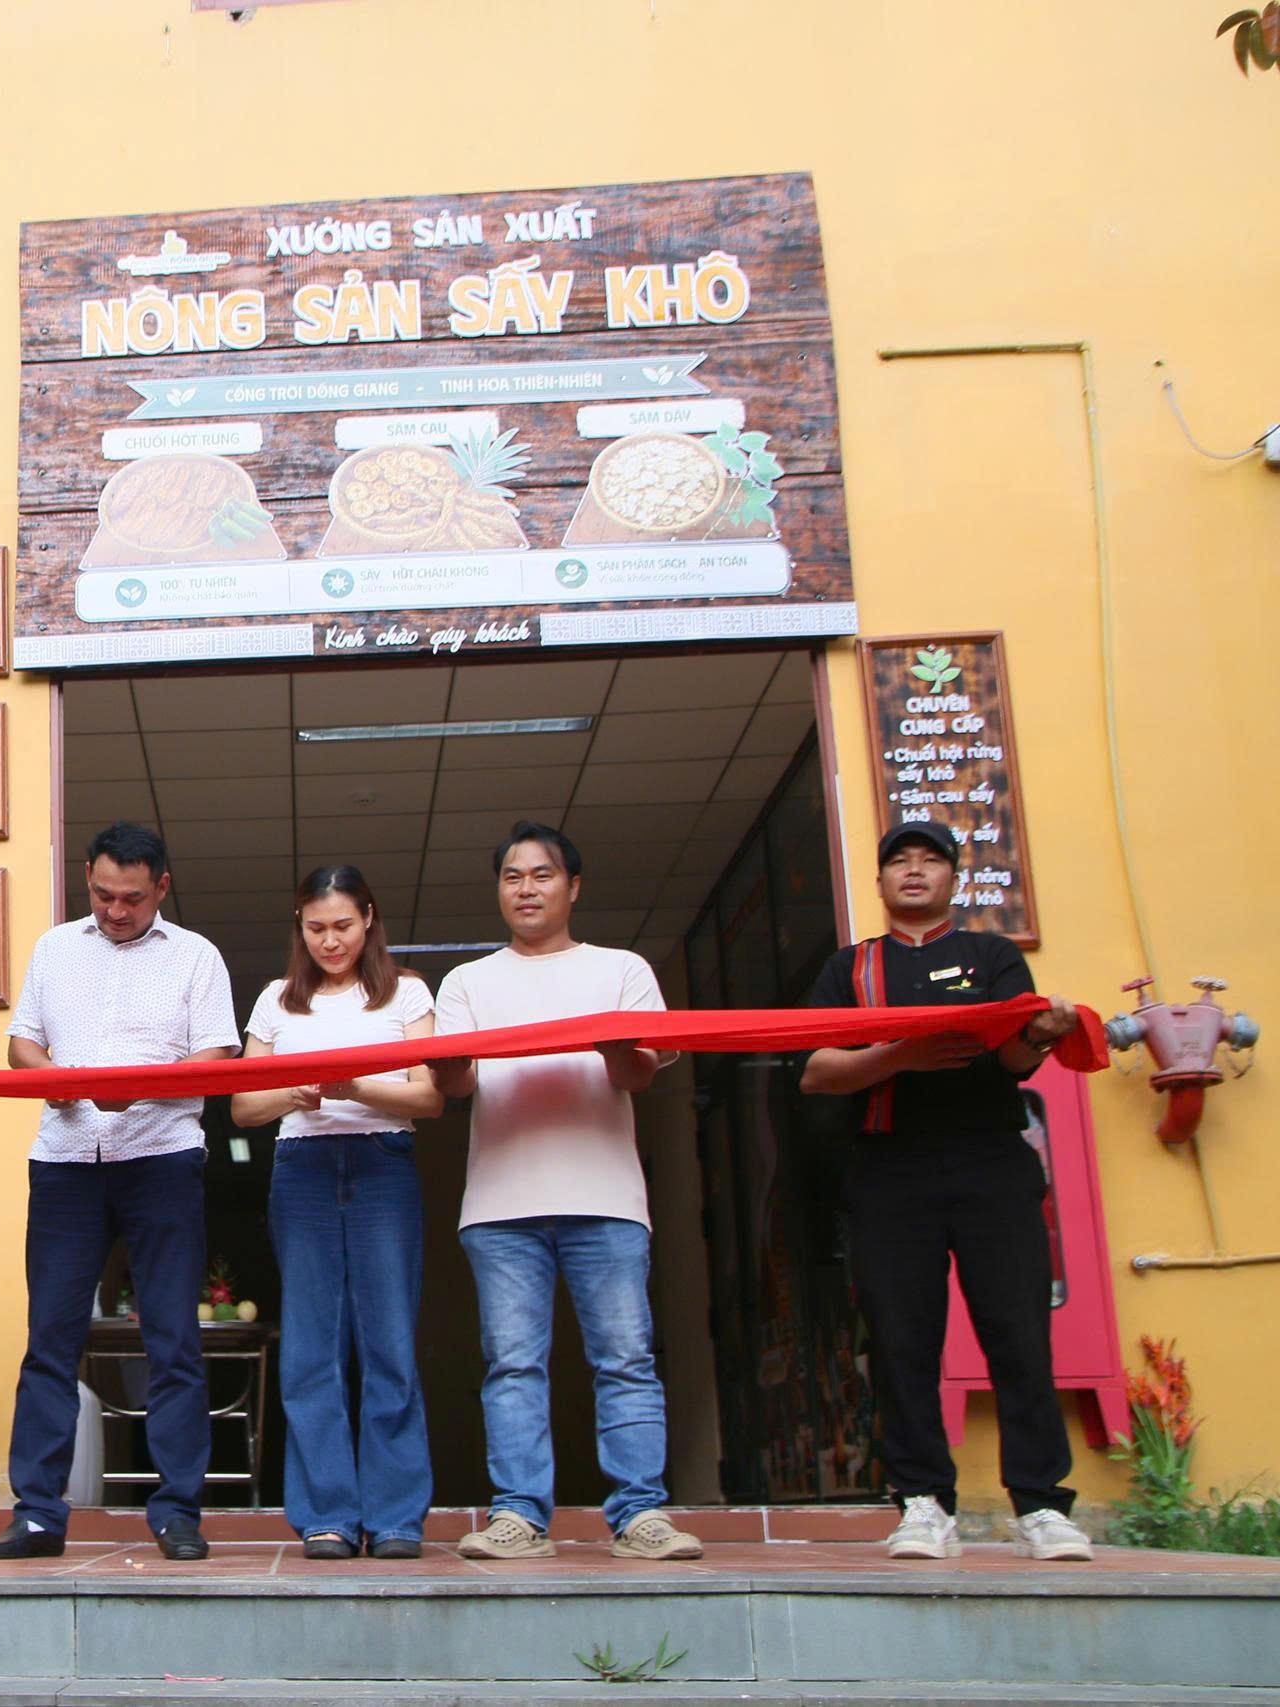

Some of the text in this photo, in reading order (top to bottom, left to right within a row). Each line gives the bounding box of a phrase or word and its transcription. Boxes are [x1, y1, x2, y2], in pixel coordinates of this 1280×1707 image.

[266, 200, 596, 258] XƯỞNG SẢN XUẤT
[81, 249, 751, 358] NÔNG SẢN SẤY KHÔ
[353, 381, 400, 398] GIANG
[440, 378, 473, 394] TINH
[478, 377, 510, 392] HOA
[324, 625, 366, 649] Kính
[375, 624, 419, 647] chào
[473, 619, 531, 644] khách
[906, 692, 970, 714] CHUYÊN
[899, 713, 985, 736] CUNG CẤP
[927, 764, 956, 781] khô
[901, 808, 932, 824] khô
[973, 866, 1012, 886] nông
[975, 889, 1005, 906] khô
